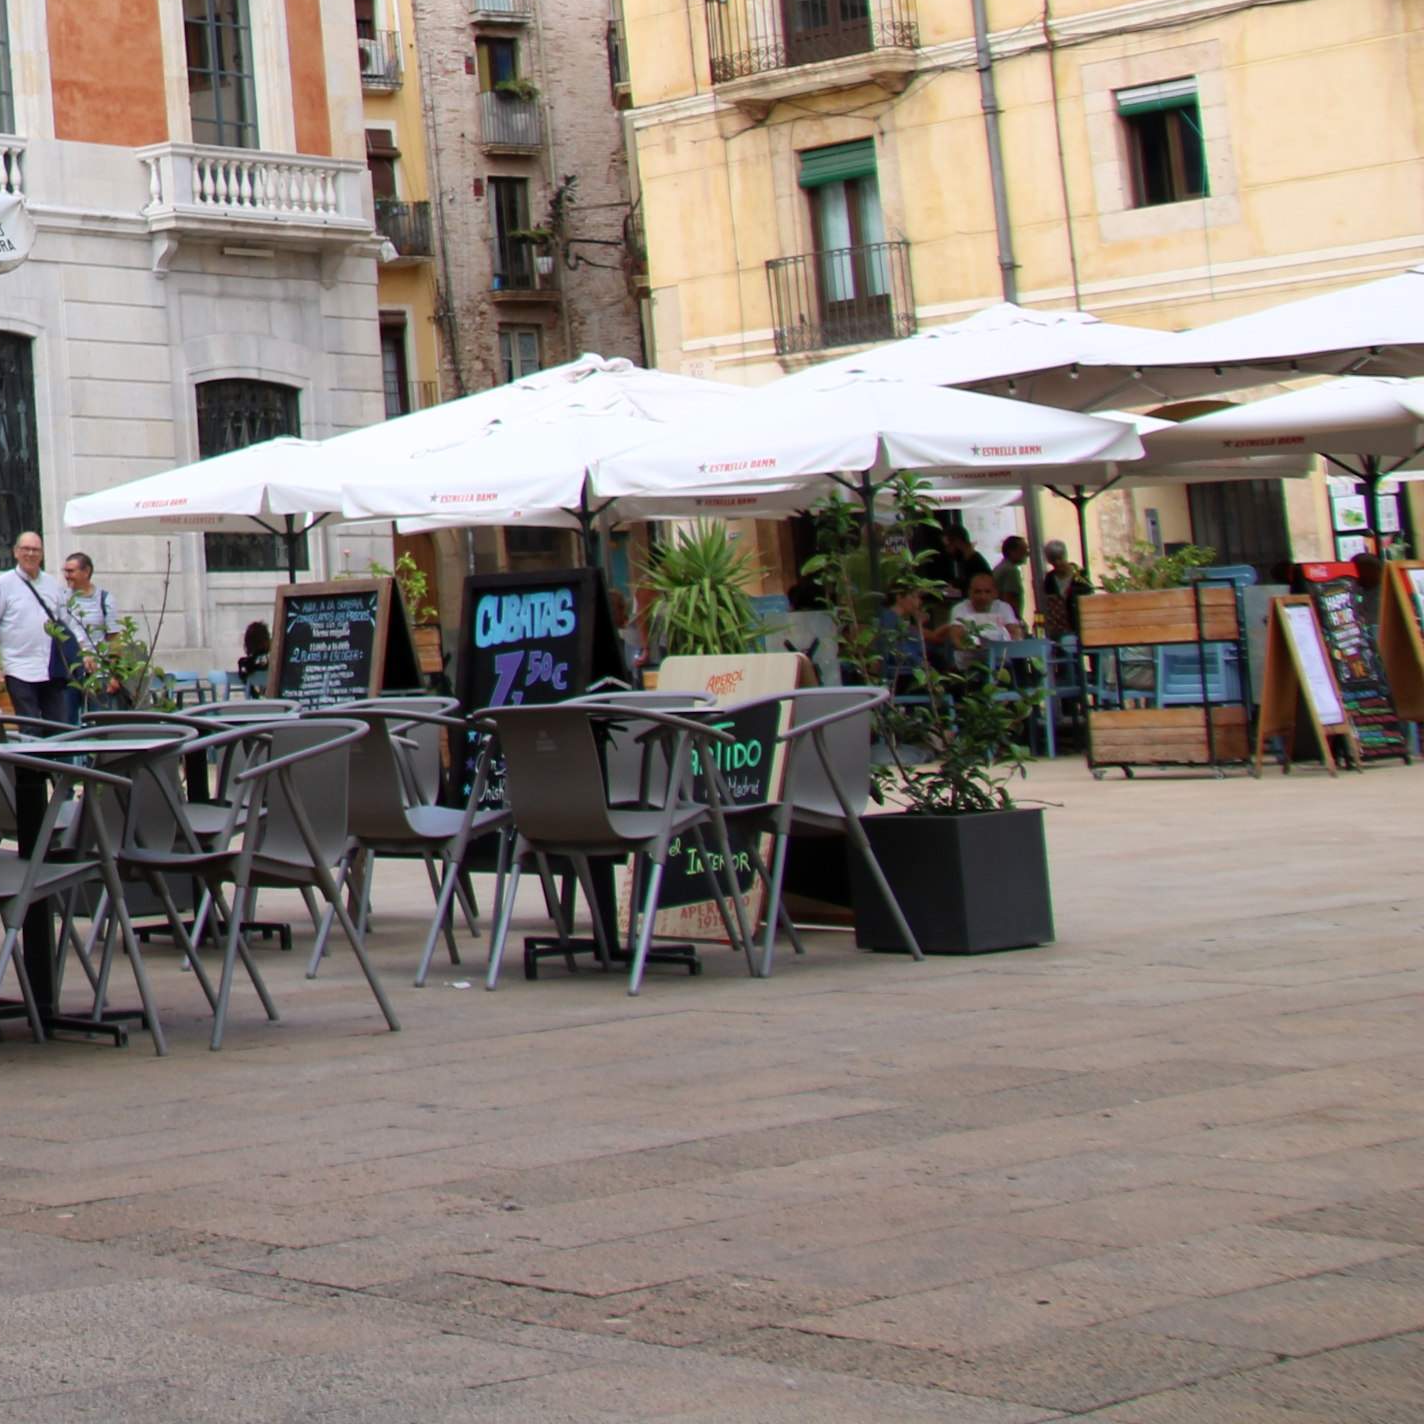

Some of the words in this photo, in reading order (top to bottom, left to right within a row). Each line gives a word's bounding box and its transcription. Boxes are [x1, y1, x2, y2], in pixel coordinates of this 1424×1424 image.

[981, 446, 1017, 458] ESTRELLA
[1019, 445, 1042, 456] DAMM
[708, 461, 749, 473] ESTRELLA
[750, 458, 776, 469] DAMM
[439, 493, 475, 504] ESTRELLA
[476, 491, 498, 502] DAMM
[475, 588, 576, 648] CUBATAS
